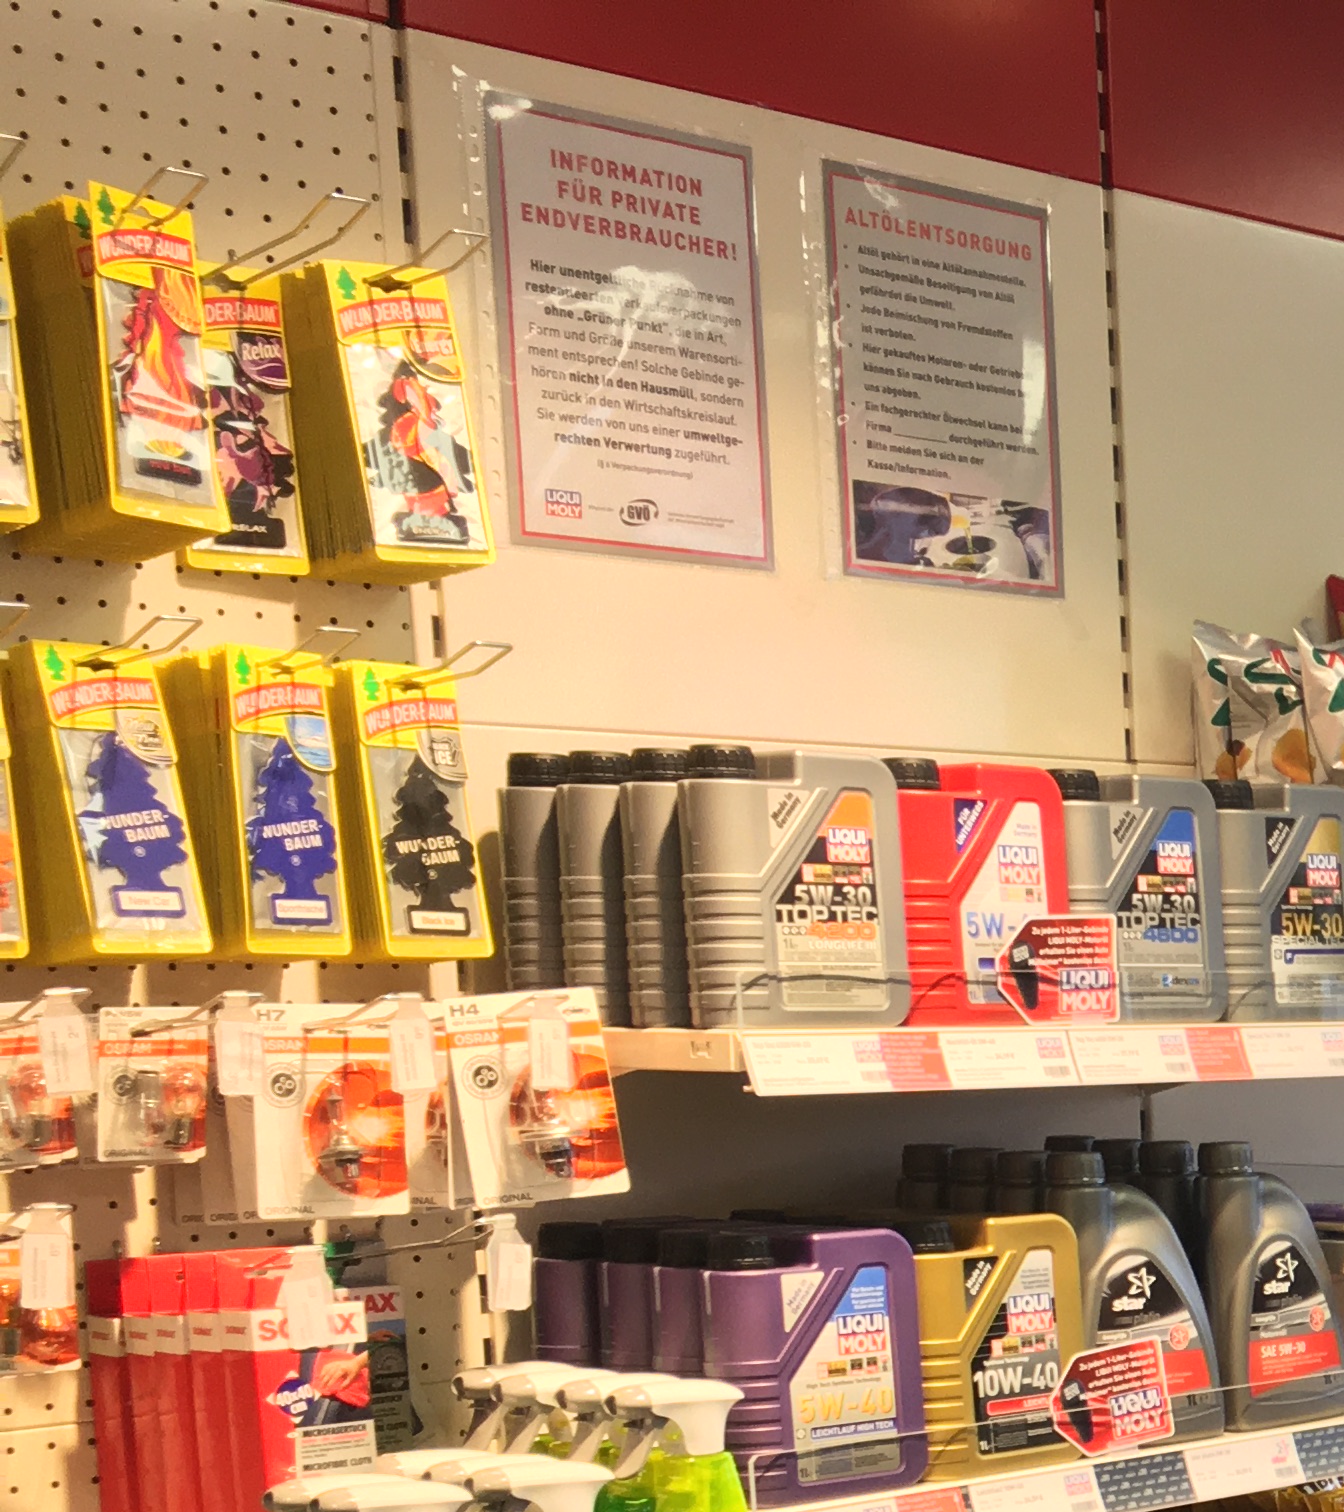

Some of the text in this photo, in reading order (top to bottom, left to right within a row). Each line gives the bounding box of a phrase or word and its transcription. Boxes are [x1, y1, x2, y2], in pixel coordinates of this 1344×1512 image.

[550, 149, 702, 197] INFORMATION
[558, 178, 701, 225] FÜR PRIVATE
[521, 202, 737, 260] ENDVERBRAUCHER!
[844, 206, 1032, 261] ALTÖLENTSORGUNG
[241, 341, 281, 364] Relax
[528, 345, 724, 385] ment entsprechen! Solche Gebinde
[569, 371, 744, 407] nicht den Hausmüll, sondern
[541, 389, 737, 426] zurück den Wirtschaftskreislauf.
[555, 432, 730, 465] rechten Verwertung zugeführt.
[546, 490, 581, 503] LIQUI
[547, 504, 581, 517] MOLY
[627, 504, 650, 522] GVÖ
[956, 800, 985, 846] UNTERWEGS
[125, 825, 170, 844] BAUM
[285, 833, 323, 849] BAUM
[828, 829, 867, 845] LIQUI
[828, 846, 870, 862] MOLY
[998, 846, 1038, 864] LIQUI
[1159, 843, 1191, 857] LIQUI
[1159, 858, 1194, 873] MOLY
[1308, 855, 1337, 869] LIQUI
[999, 865, 1040, 885] MOLY
[1308, 870, 1339, 886] MOLY
[794, 884, 872, 905] 5W-30
[1132, 894, 1195, 913] 5W-30
[776, 905, 878, 925] TOP TEC
[1117, 912, 1200, 930] TOP TEC
[1282, 914, 1343, 935] 5W-30
[808, 922, 877, 940] 4200
[1271, 936, 1318, 946] SPECIAL
[1061, 971, 1109, 990] LIQUI
[448, 1002, 481, 1020] H4
[1061, 992, 1111, 1012] MOLY
[256, 1009, 285, 1022] H7
[104, 1042, 152, 1055] OSRAM
[103, 1149, 153, 1158] ORIGINAL
[483, 1190, 534, 1204] ORIGINAL
[1262, 1279, 1292, 1297] star
[1008, 1294, 1052, 1314] LIQUI
[1111, 1295, 1147, 1313] star
[837, 1314, 885, 1335] LIQUI
[1008, 1312, 1054, 1334] MOLY
[838, 1332, 887, 1355] MOLY
[1260, 1343, 1283, 1359] SAE
[973, 1362, 1059, 1398] 10W-40
[798, 1386, 894, 1424] 5W-40
[1110, 1388, 1163, 1416] LIQUI
[811, 1420, 895, 1440] LEICHTLAUF HIGH TECH
[1114, 1407, 1163, 1438] MOLY
